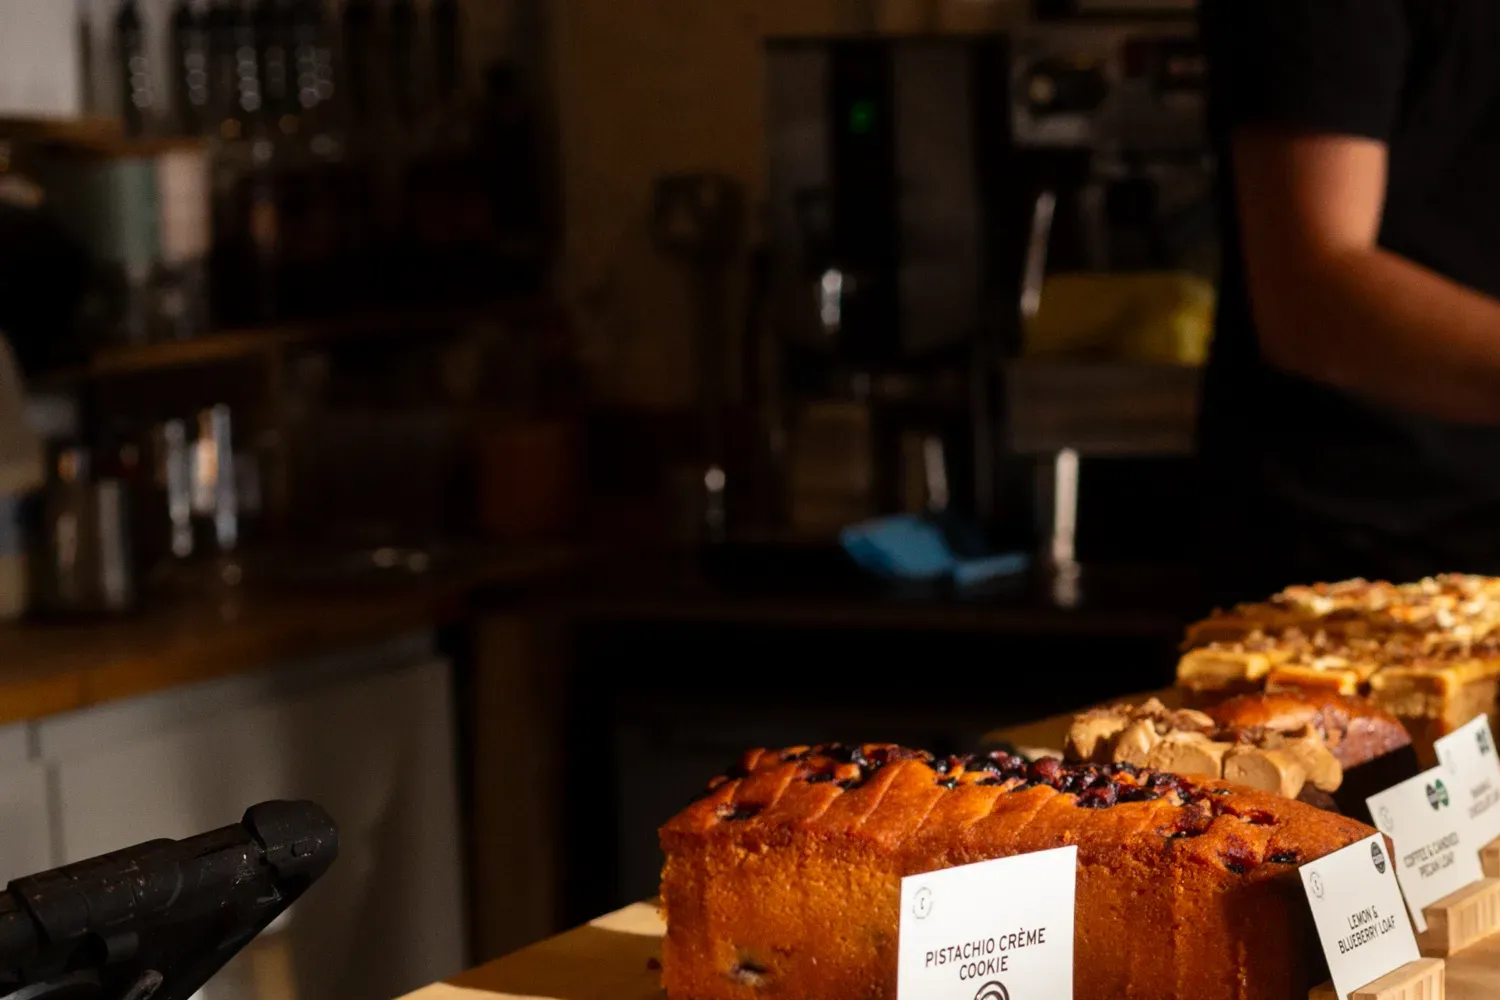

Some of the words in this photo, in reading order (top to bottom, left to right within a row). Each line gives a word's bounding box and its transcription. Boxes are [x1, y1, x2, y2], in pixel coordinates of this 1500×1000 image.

[1337, 926, 1381, 955] BLUEBERRY
[1379, 914, 1396, 935] LOAF
[1346, 908, 1371, 931] LEMON
[1371, 904, 1379, 919] &
[925, 937, 995, 968] PISTACHIO
[999, 927, 1046, 951] CRÈME
[959, 955, 1009, 981] COOKIE
